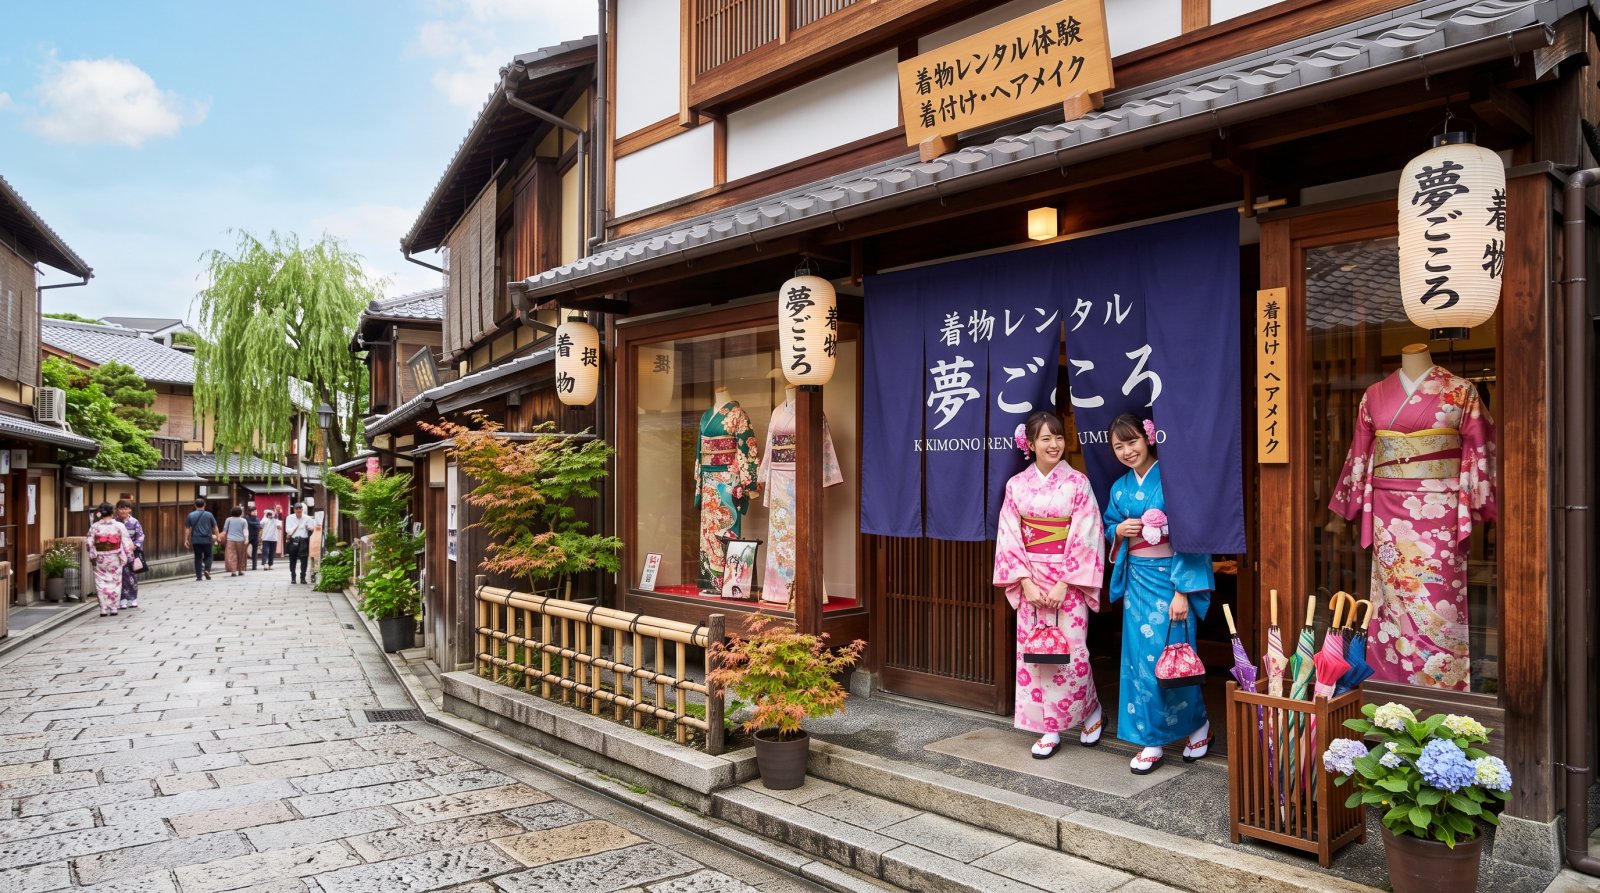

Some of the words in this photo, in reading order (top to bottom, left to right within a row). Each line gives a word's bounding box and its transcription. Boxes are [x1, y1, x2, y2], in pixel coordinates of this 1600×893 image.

[915, 15, 1084, 96] 着物レンタル体験
[920, 55, 1085, 129] 着付け・ヘアメイク
[1411, 160, 1470, 311] 夢ごころ
[1481, 188, 1507, 279] 着物
[581, 347, 598, 368] 提
[785, 285, 815, 376] 夢ごころ
[823, 305, 837, 359] 着物
[940, 293, 1133, 347] 着物レンタル
[556, 333, 576, 394] 着物
[927, 343, 1163, 431] 夢ごころ
[1262, 300, 1281, 454] 着付け・ヘアメイク
[925, 437, 981, 451] KIMONO
[983, 436, 1016, 450] REN
